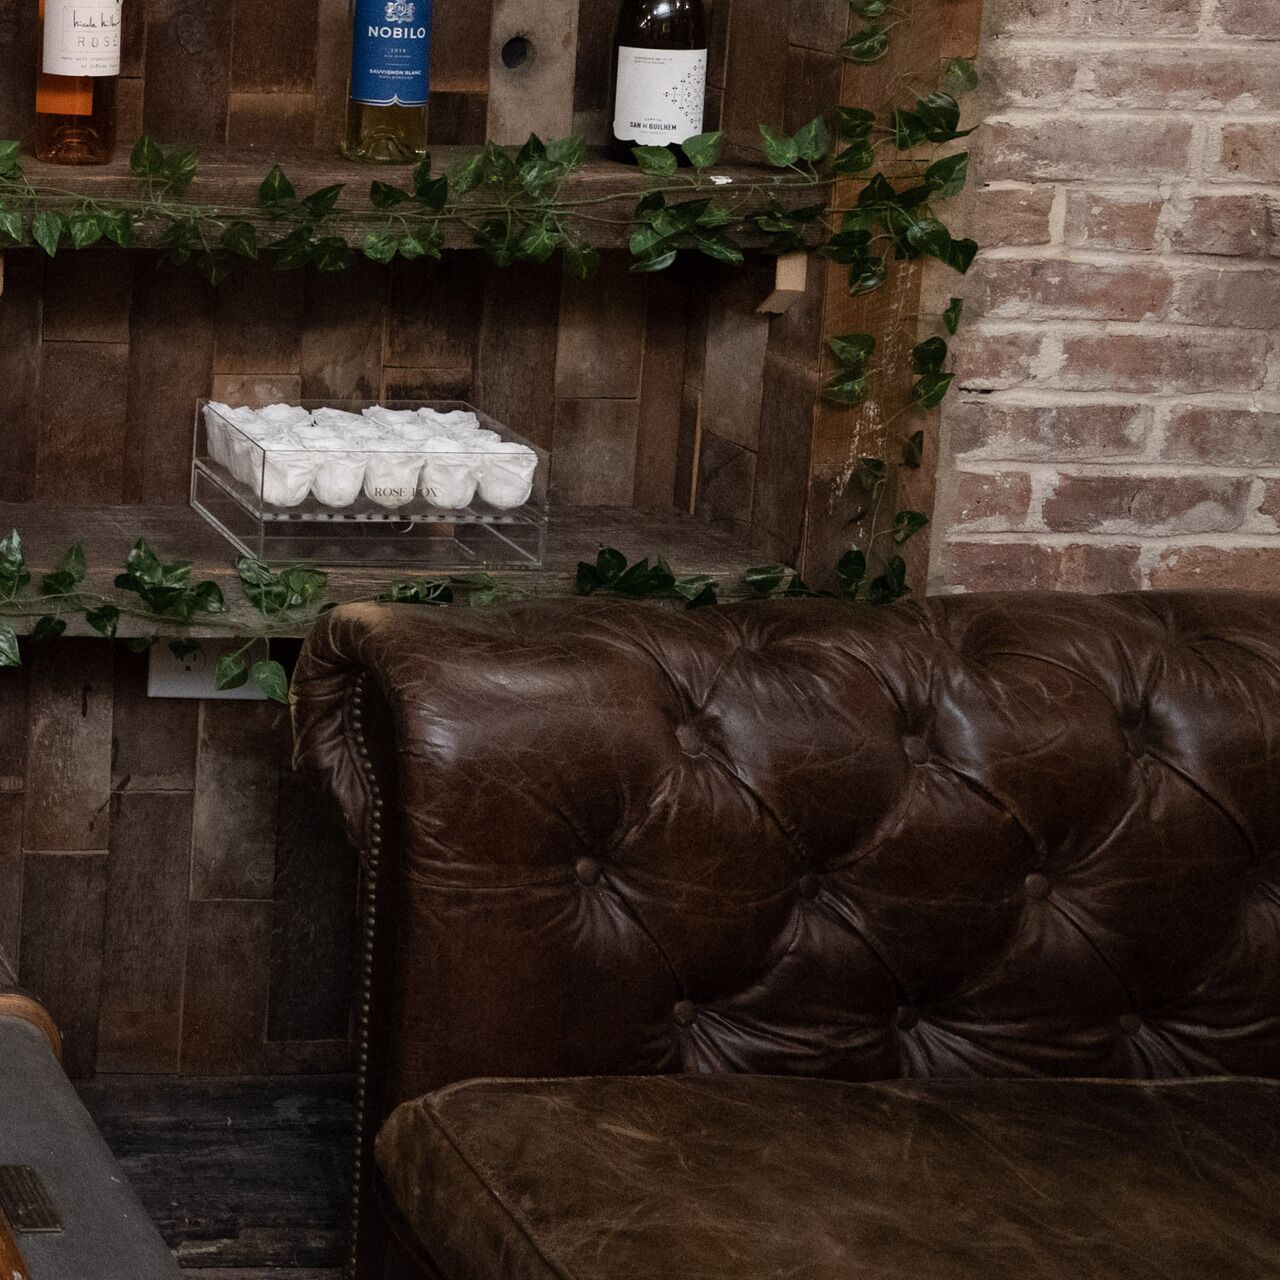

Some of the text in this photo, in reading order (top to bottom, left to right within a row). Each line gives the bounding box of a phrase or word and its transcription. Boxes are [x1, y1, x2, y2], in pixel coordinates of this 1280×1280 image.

[368, 25, 426, 39] NOBILO
[630, 121, 642, 129] SAN
[648, 123, 677, 131] GUILHEM
[374, 487, 407, 497] ROSE
